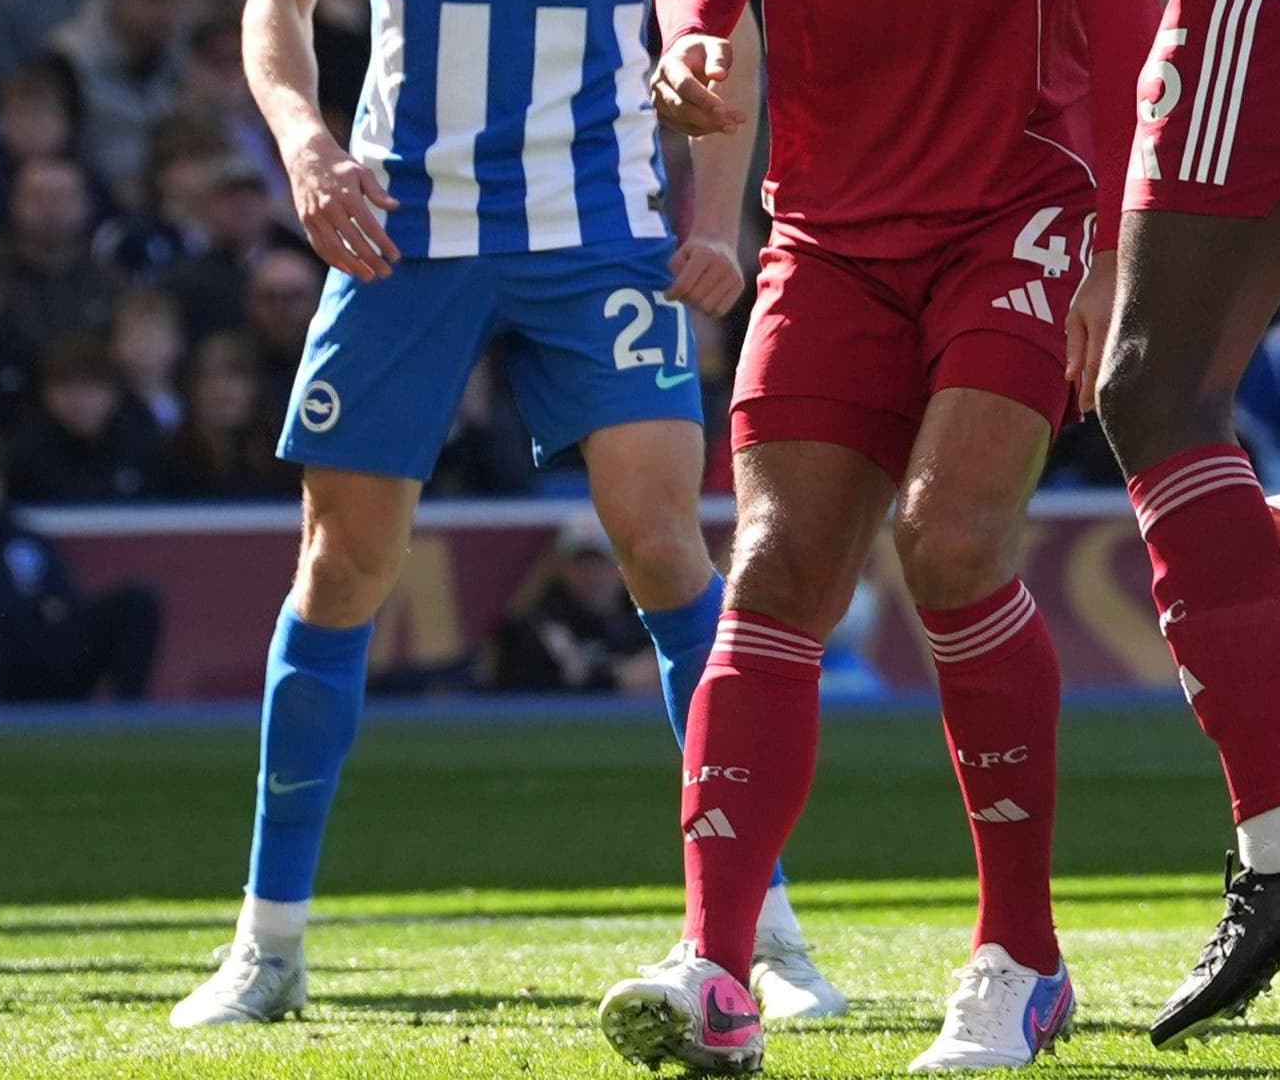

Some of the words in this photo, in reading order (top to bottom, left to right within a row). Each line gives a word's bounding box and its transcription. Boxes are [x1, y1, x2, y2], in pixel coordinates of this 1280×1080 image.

[1136, 28, 1188, 123] 5
[1012, 206, 1071, 278] 4
[683, 765, 751, 788] LFC
[957, 744, 1028, 769] LFC
